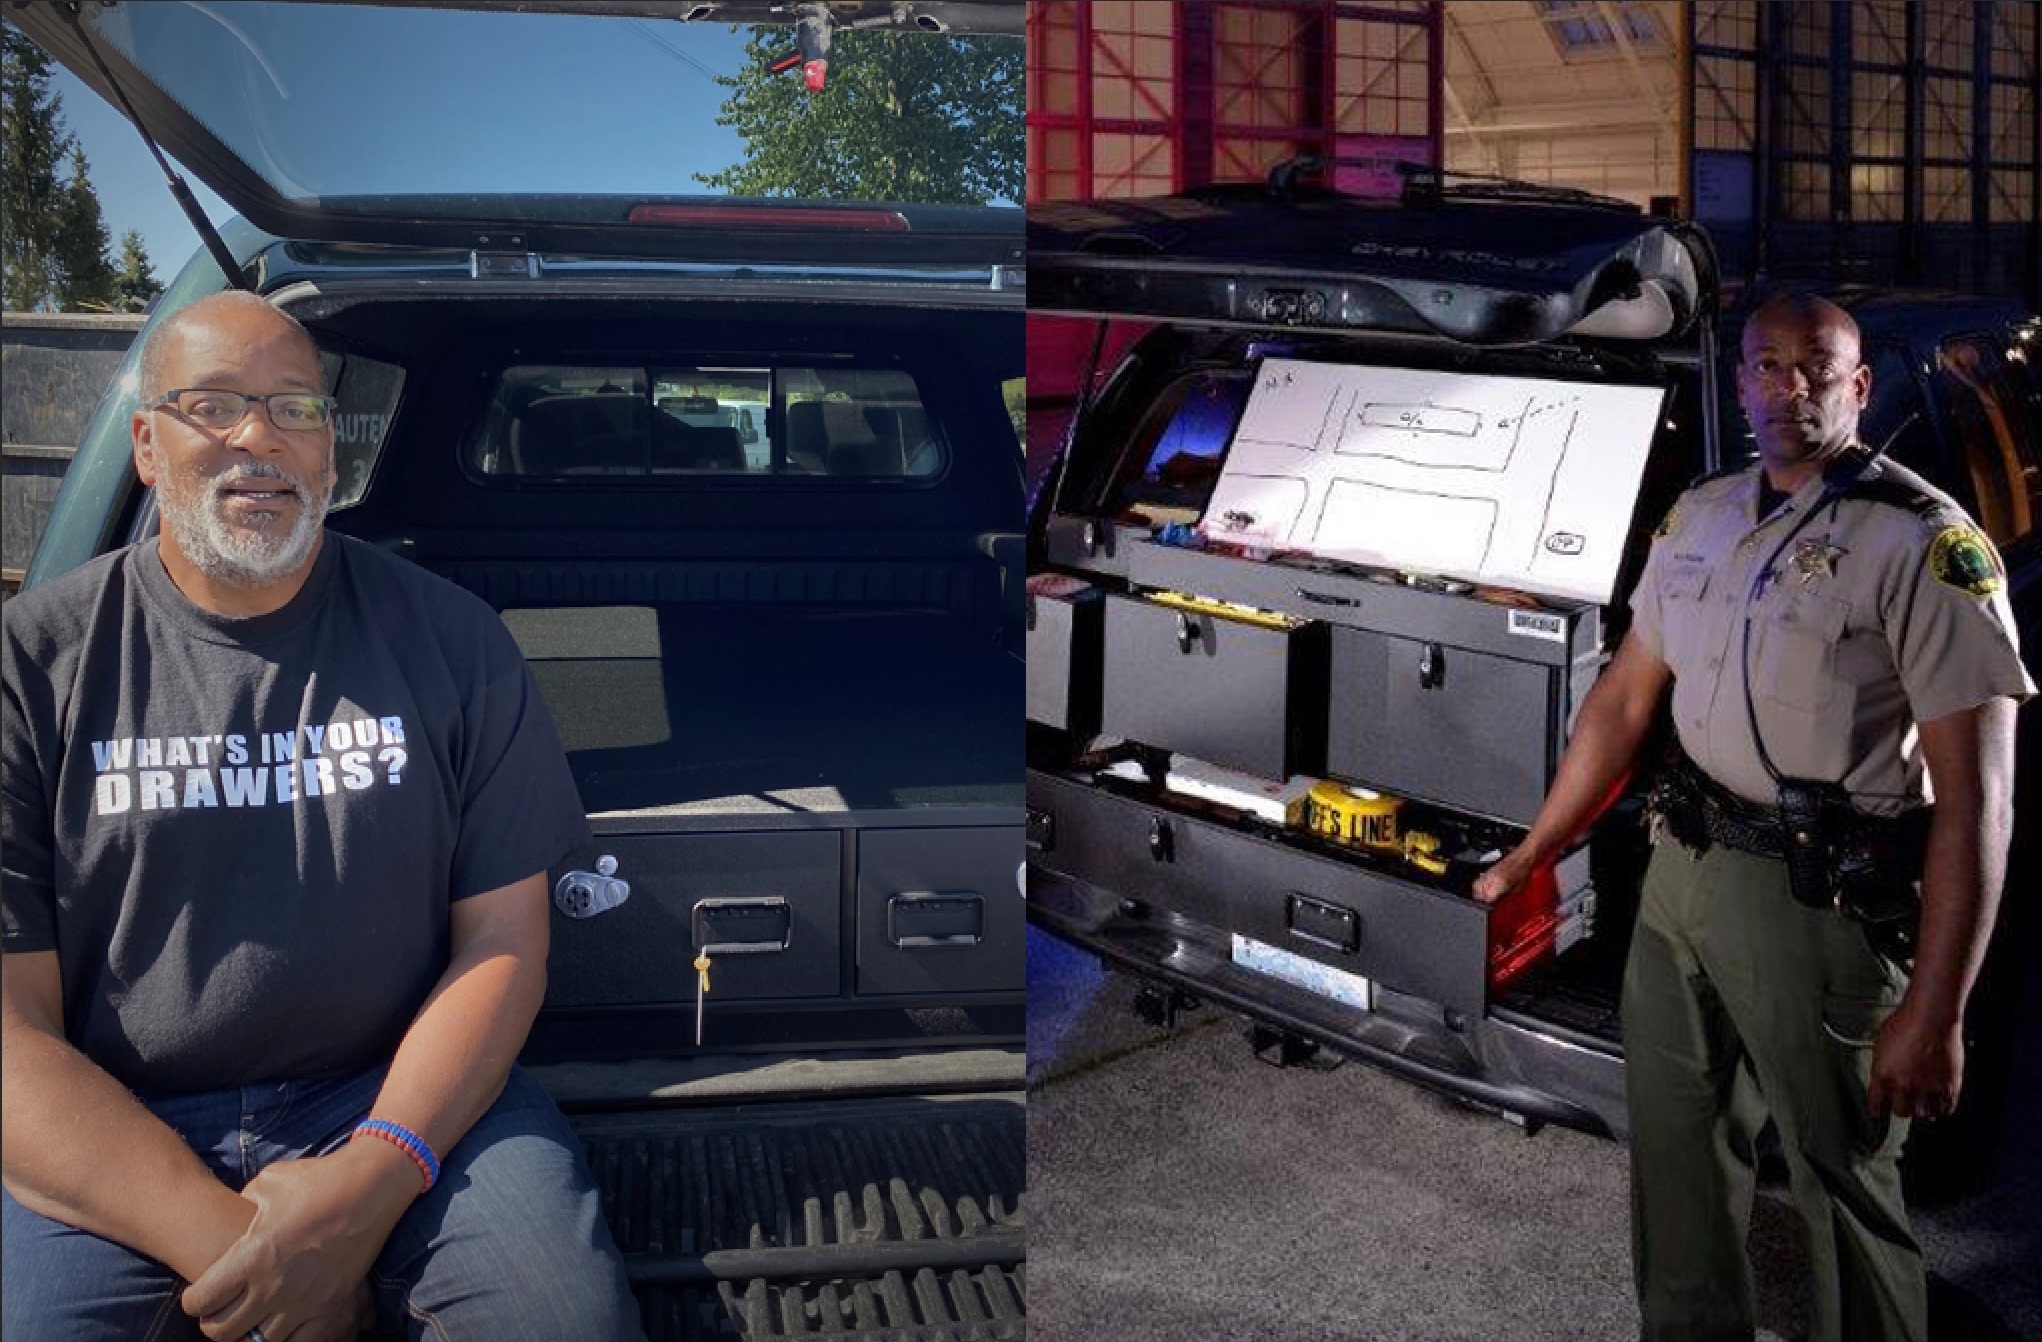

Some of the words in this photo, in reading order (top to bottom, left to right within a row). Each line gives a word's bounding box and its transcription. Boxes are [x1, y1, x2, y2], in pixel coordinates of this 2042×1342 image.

[91, 733, 249, 772] WHAT'S
[261, 730, 297, 765] IN
[303, 715, 406, 754] YOUR
[95, 746, 408, 816] DRAWERS?
[1350, 813, 1395, 843] LINE
